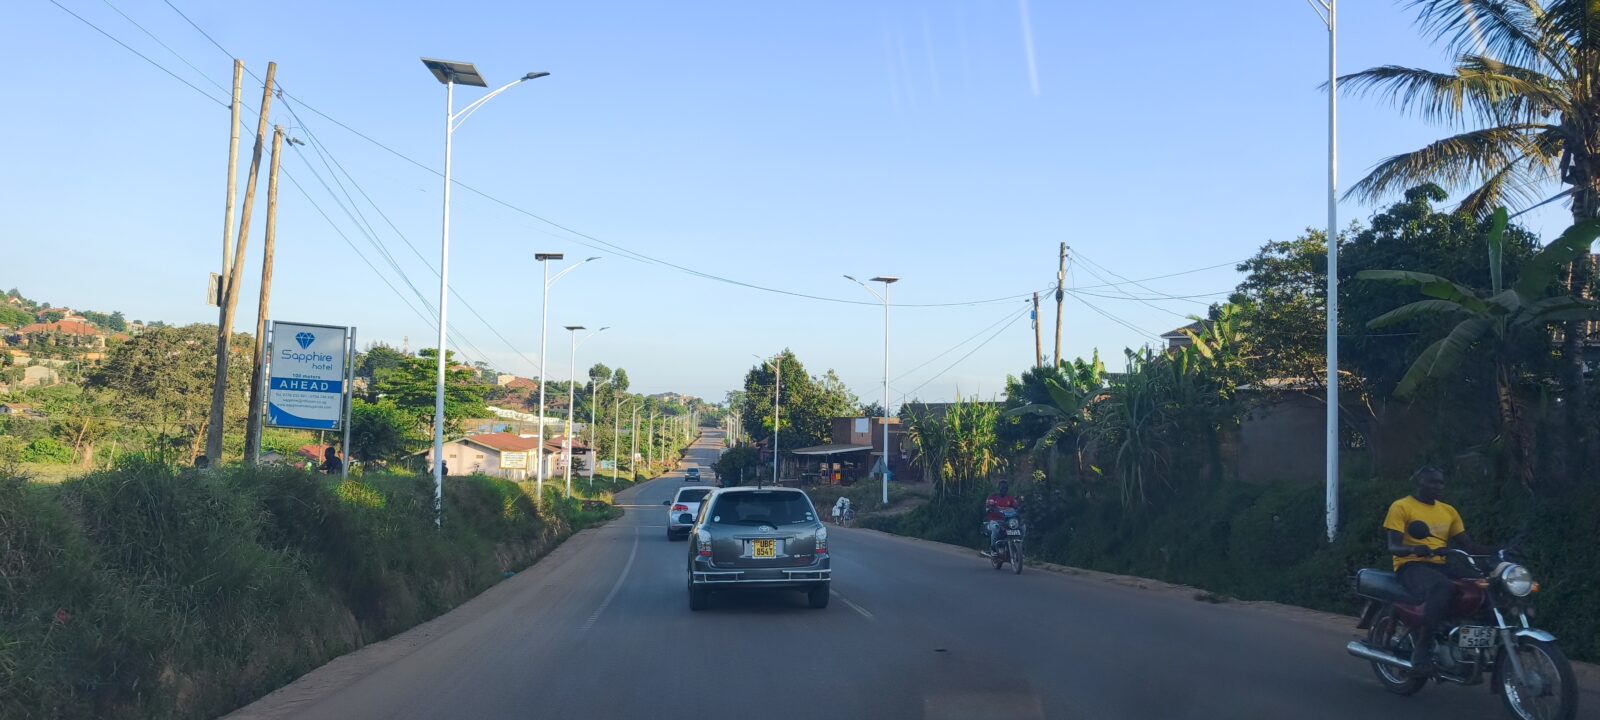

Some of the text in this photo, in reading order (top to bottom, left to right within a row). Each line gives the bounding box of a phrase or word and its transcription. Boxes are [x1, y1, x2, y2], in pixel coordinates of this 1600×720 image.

[281, 349, 333, 363] Sapphire
[279, 380, 329, 391] AHEAD
[760, 540, 773, 548] UBF
[756, 548, 773, 556] 854T
